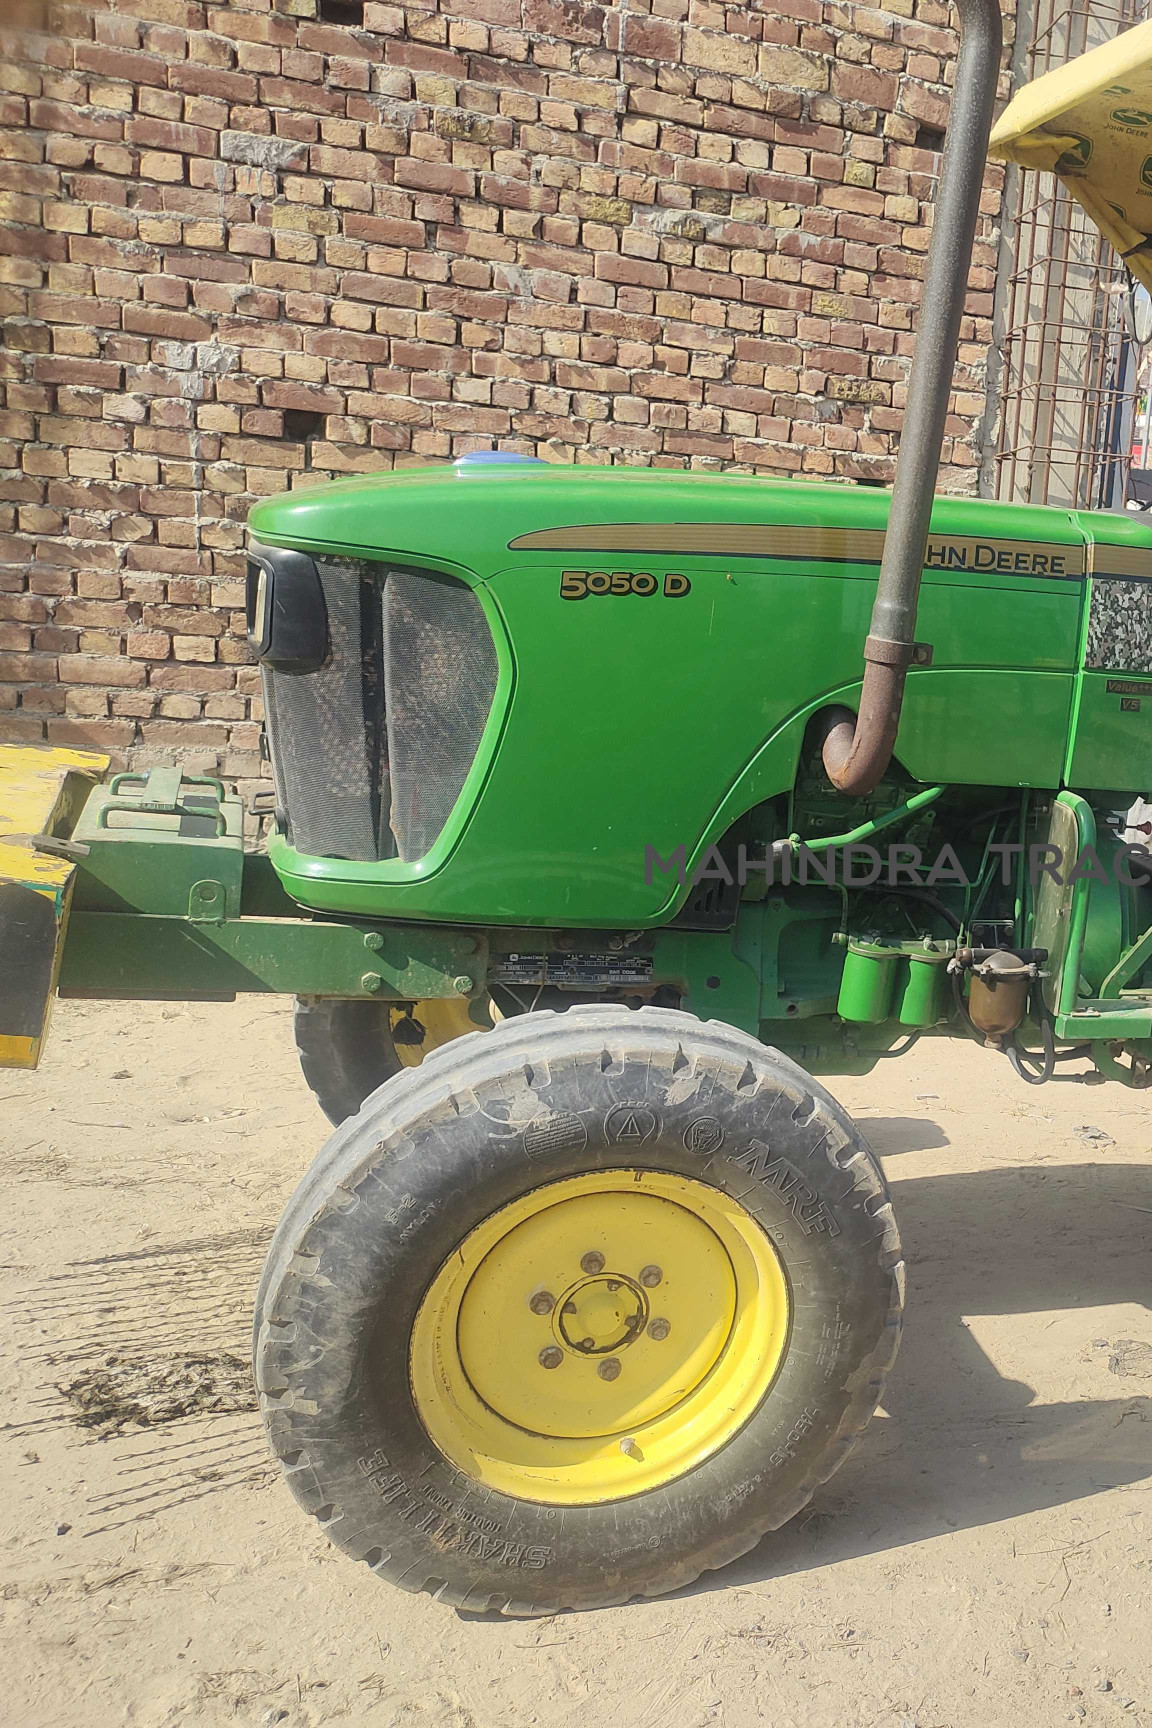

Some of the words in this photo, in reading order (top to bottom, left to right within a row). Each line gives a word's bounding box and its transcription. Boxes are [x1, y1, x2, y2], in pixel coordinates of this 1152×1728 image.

[1104, 122, 1125, 133] JOHN
[1126, 128, 1149, 138] DEERE
[927, 544, 967, 567] HN
[975, 544, 1066, 574] DEERE
[560, 571, 658, 600] 5050
[664, 573, 691, 598] D
[1122, 698, 1139, 711] V5
[726, 1138, 841, 1238] MRF
[384, 1192, 417, 1226] F-2
[420, 1485, 453, 1512] FRONT
[455, 1507, 502, 1533] TRACTOR
